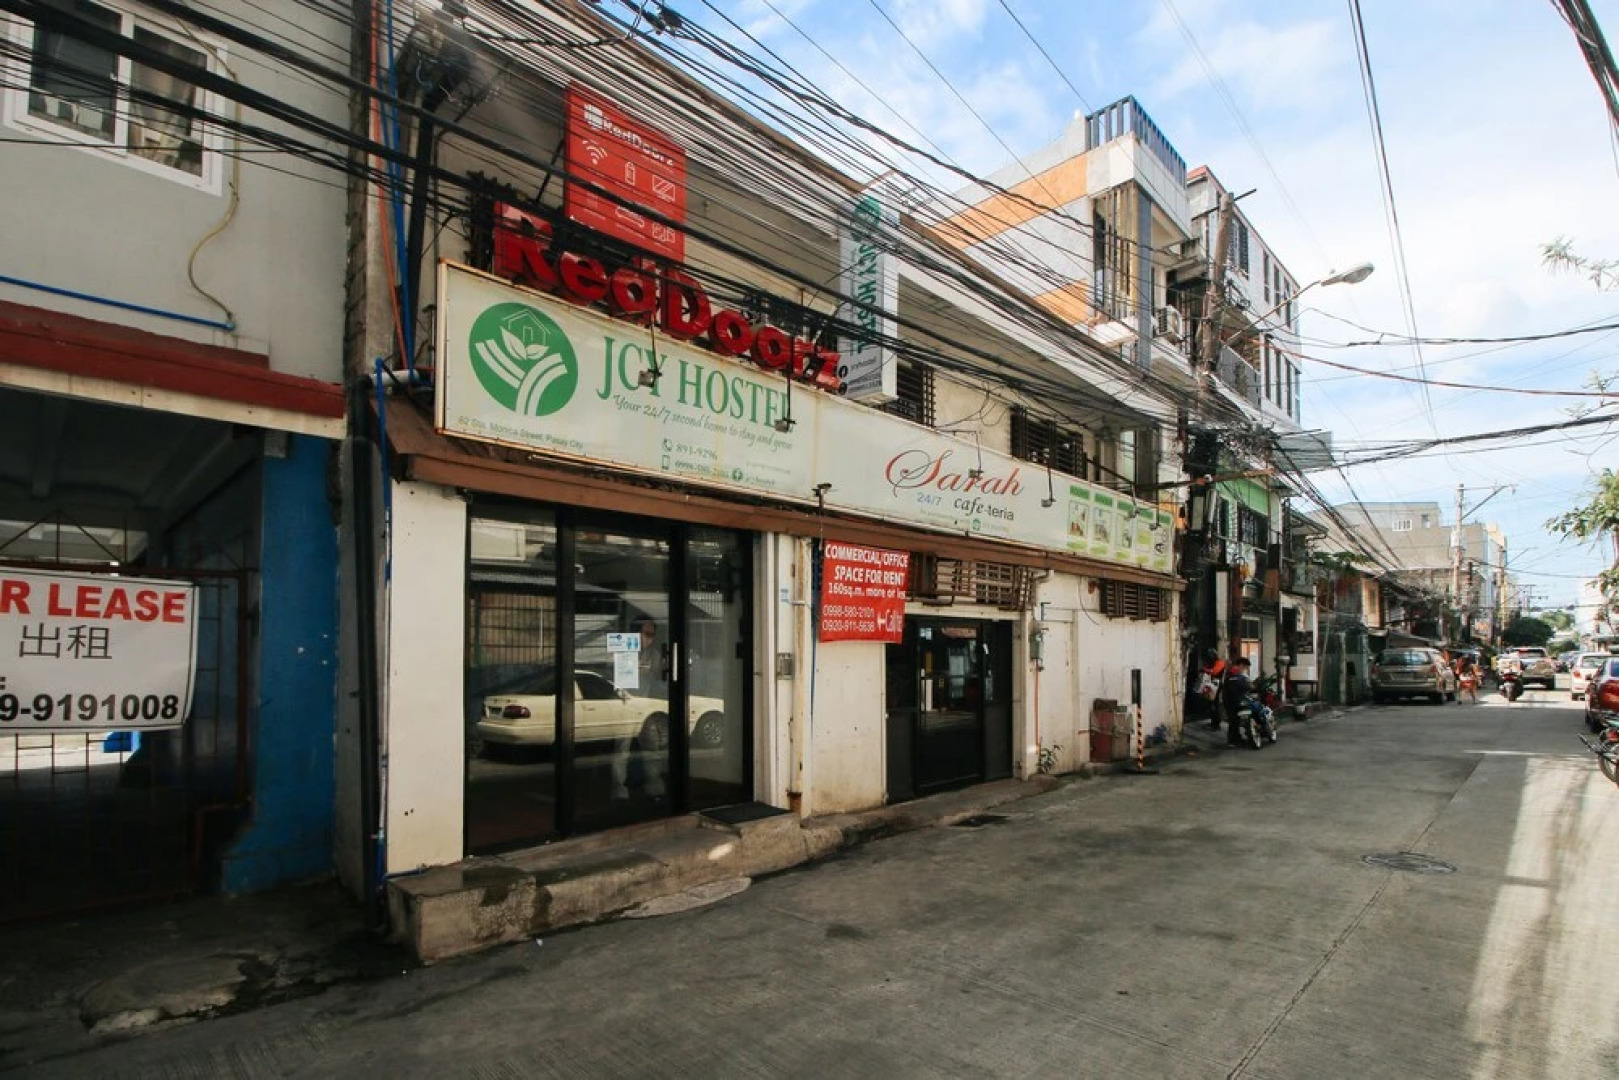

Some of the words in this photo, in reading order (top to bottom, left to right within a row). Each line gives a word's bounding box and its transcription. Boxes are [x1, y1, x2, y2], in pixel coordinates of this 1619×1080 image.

[494, 202, 842, 391] RedDoorz
[596, 336, 667, 400] JCY
[613, 394, 641, 411] Your
[643, 405, 671, 424] 24/7
[672, 413, 703, 429] second
[703, 415, 728, 434] home
[729, 423, 739, 436] to
[757, 432, 773, 446] and
[885, 449, 1024, 497] Sarah
[917, 491, 942, 506] 24/7
[953, 496, 1015, 521] cafe-teria
[834, 564, 864, 582] SPACE
[866, 567, 882, 584] FOR
[884, 570, 905, 586] RENT
[48, 583, 187, 623] LEASE
[19, 622, 113, 660] 出租
[0, 693, 179, 721] 9-9191008
